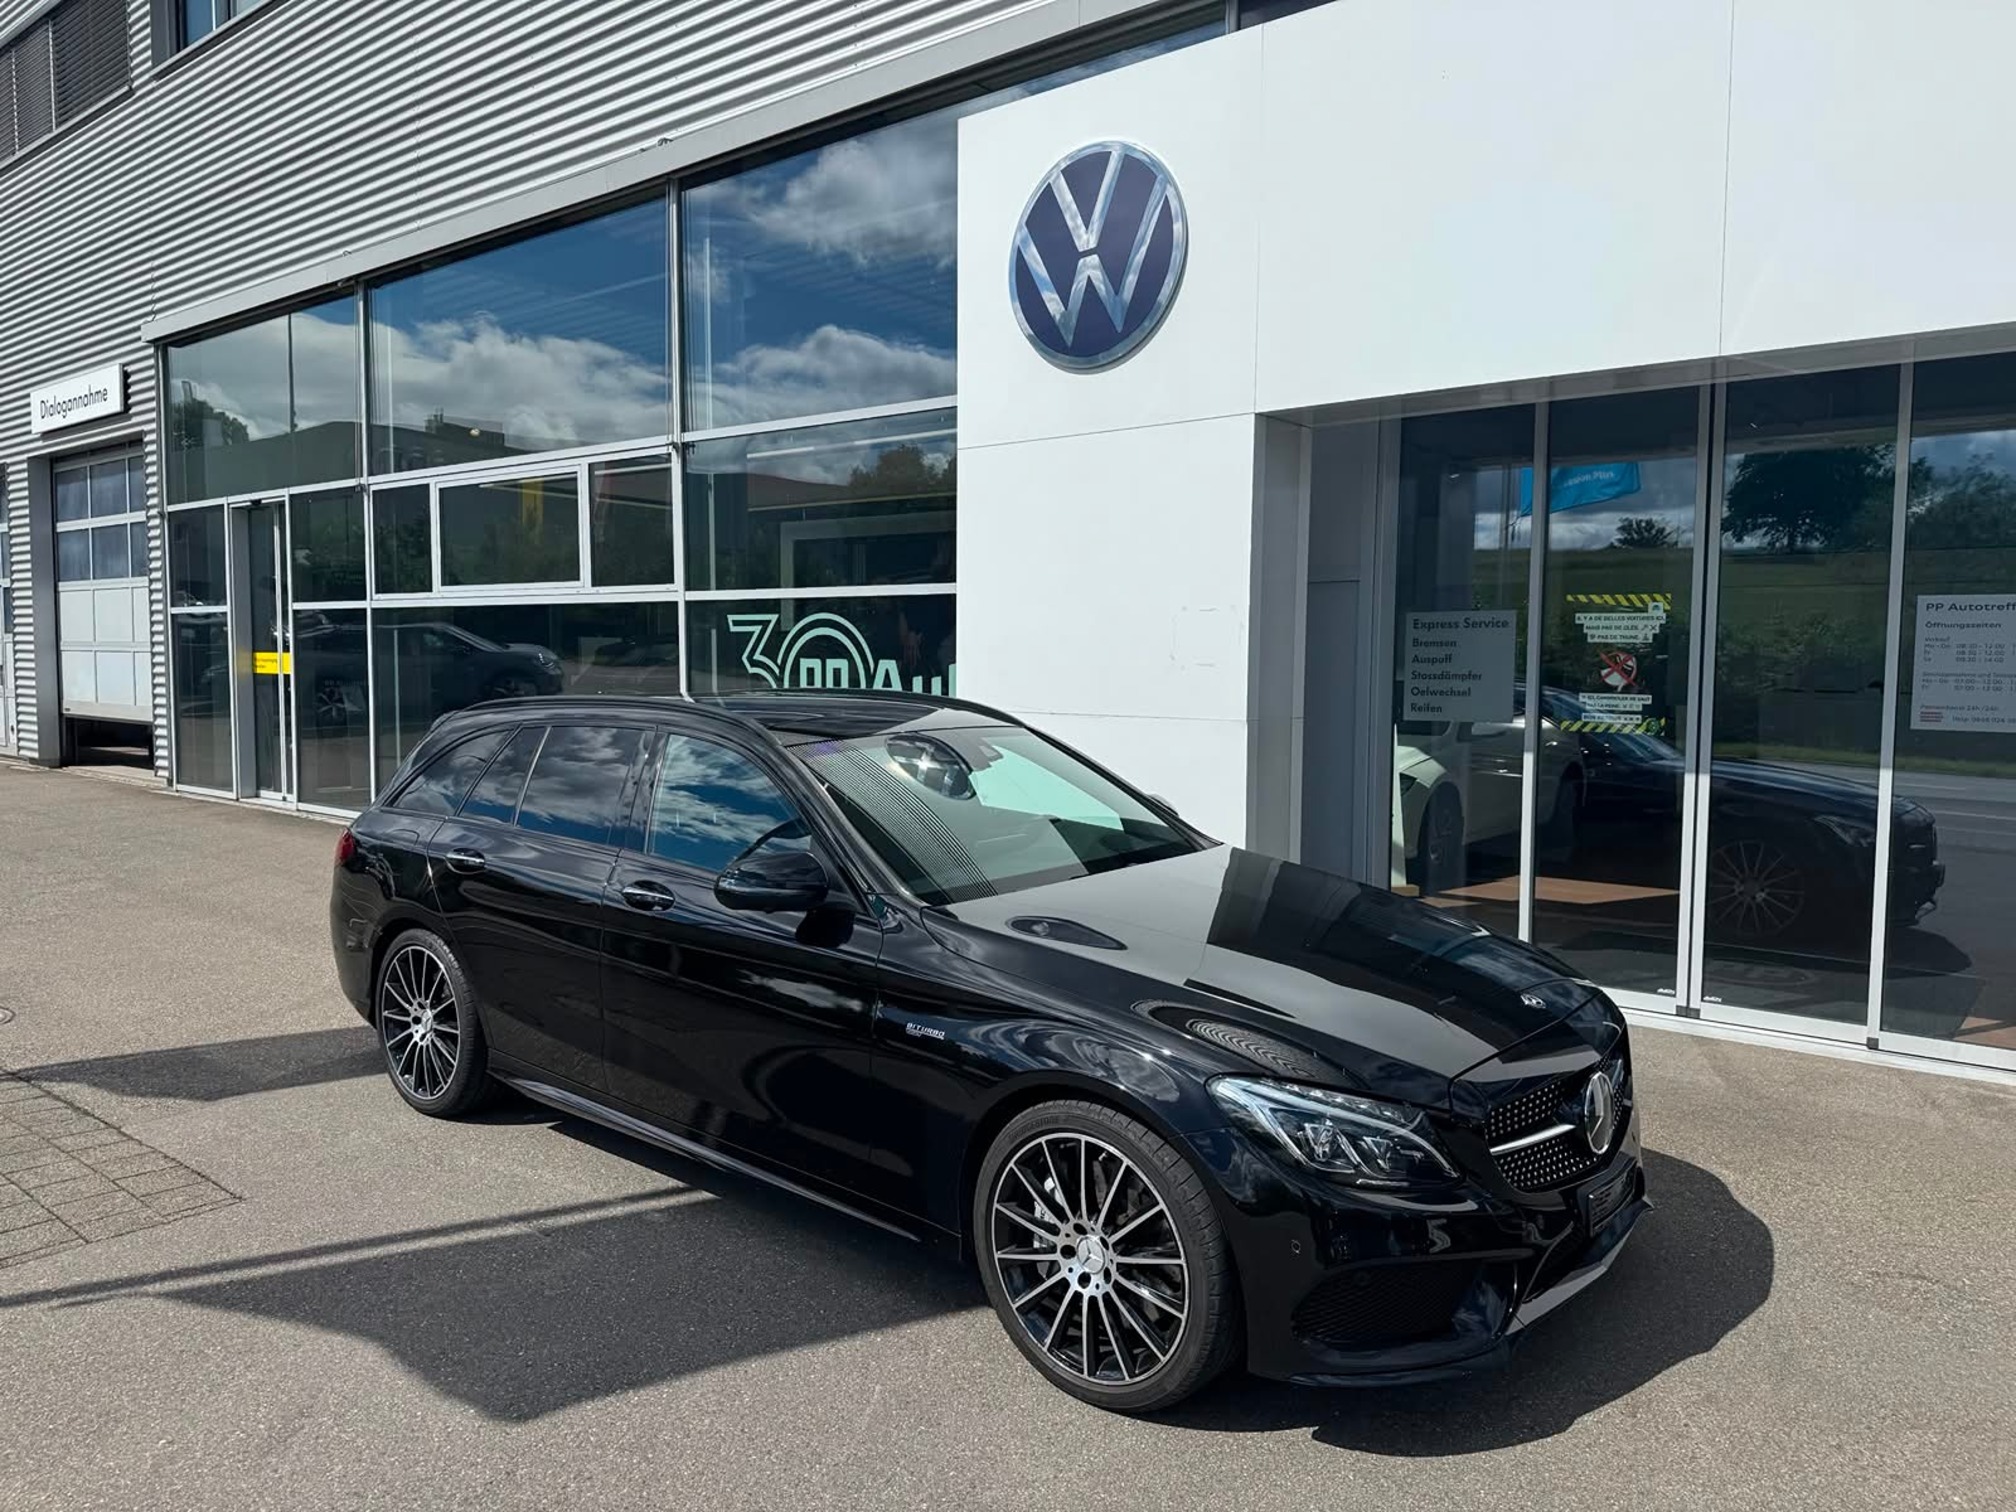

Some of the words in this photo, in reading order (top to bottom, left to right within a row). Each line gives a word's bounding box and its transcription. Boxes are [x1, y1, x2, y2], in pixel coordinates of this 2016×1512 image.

[1013, 145, 1180, 360] VW
[40, 384, 108, 419] Dialogannahme
[1925, 603, 1944, 612] PP
[1412, 619, 1460, 632] Express
[1463, 617, 1509, 629] Service
[1924, 621, 2002, 630] Öffnungszeiten
[1412, 638, 1457, 648] Bremsen
[1411, 670, 1482, 682] Stossdämpfer
[1410, 686, 1471, 697] Oelwechsel
[1410, 702, 1443, 713] Reifen
[906, 1022, 945, 1037] BITURBO
